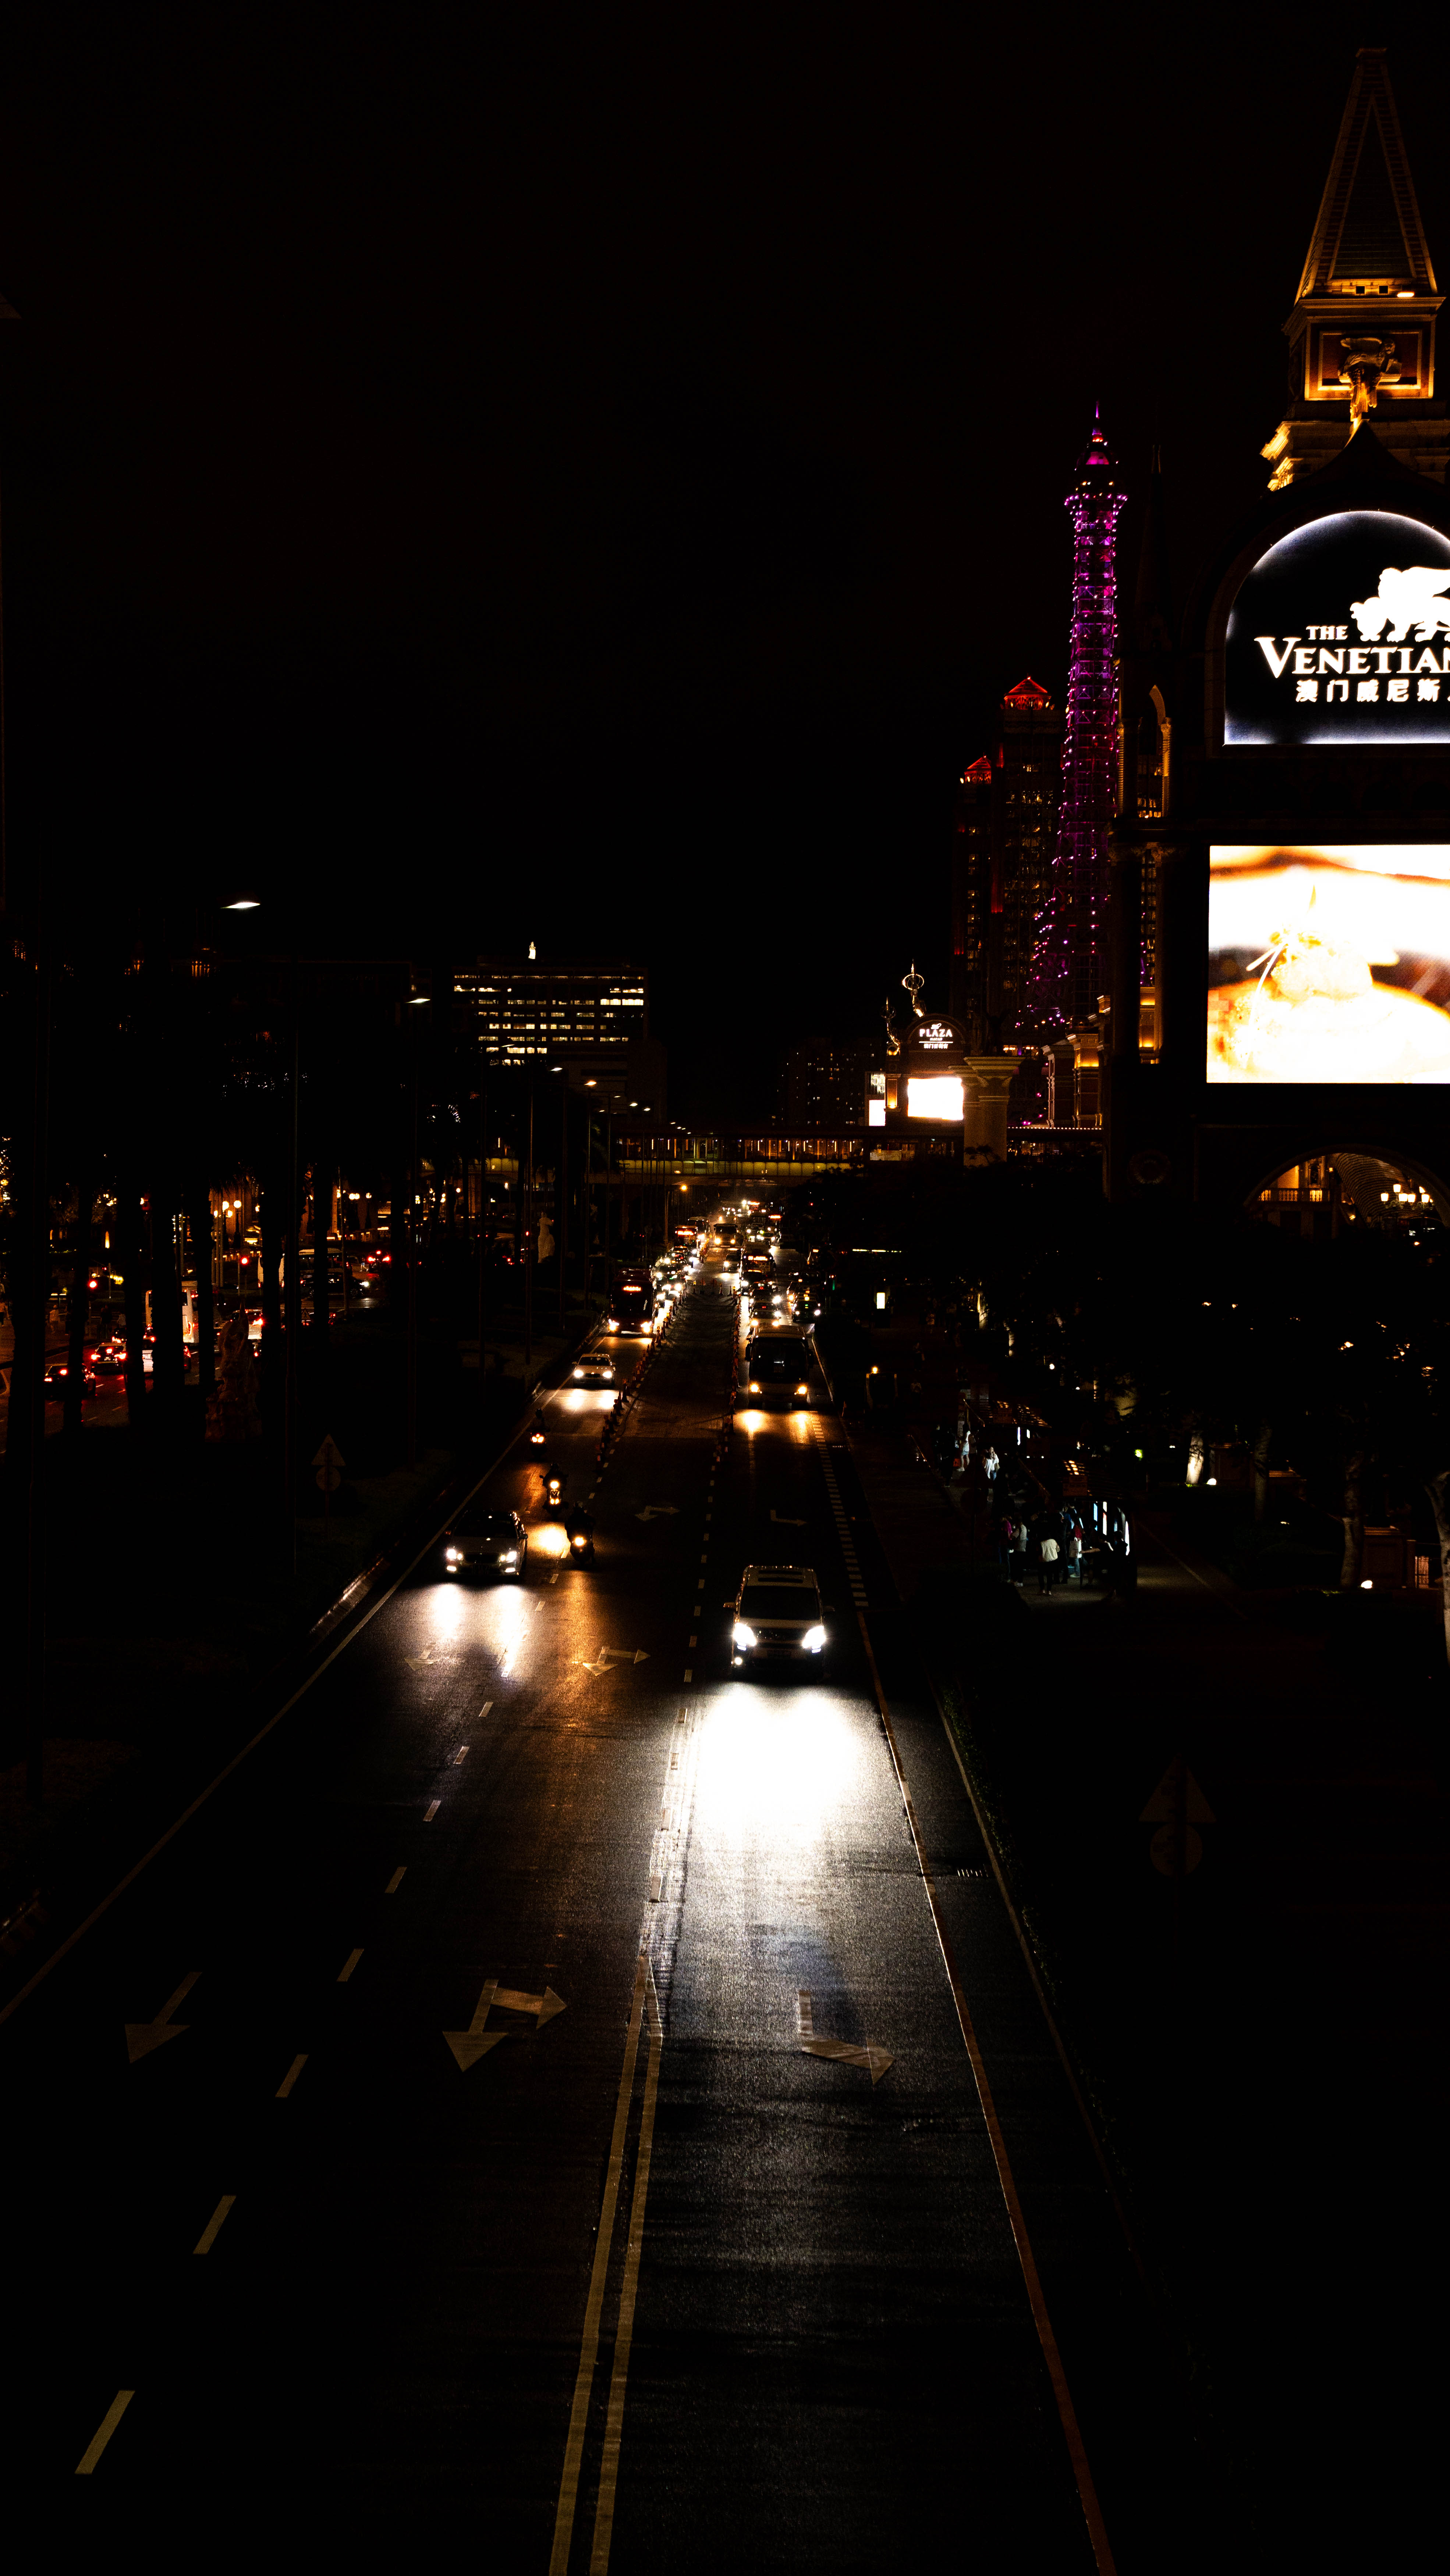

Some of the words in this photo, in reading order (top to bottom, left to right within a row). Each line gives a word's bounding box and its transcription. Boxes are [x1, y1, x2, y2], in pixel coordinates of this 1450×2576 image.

[1305, 625, 1348, 640] THE
[1254, 637, 1450, 679] VENETIA
[1295, 679, 1450, 702] 澳门威尼斯
[919, 1029, 953, 1037] PLAZA
